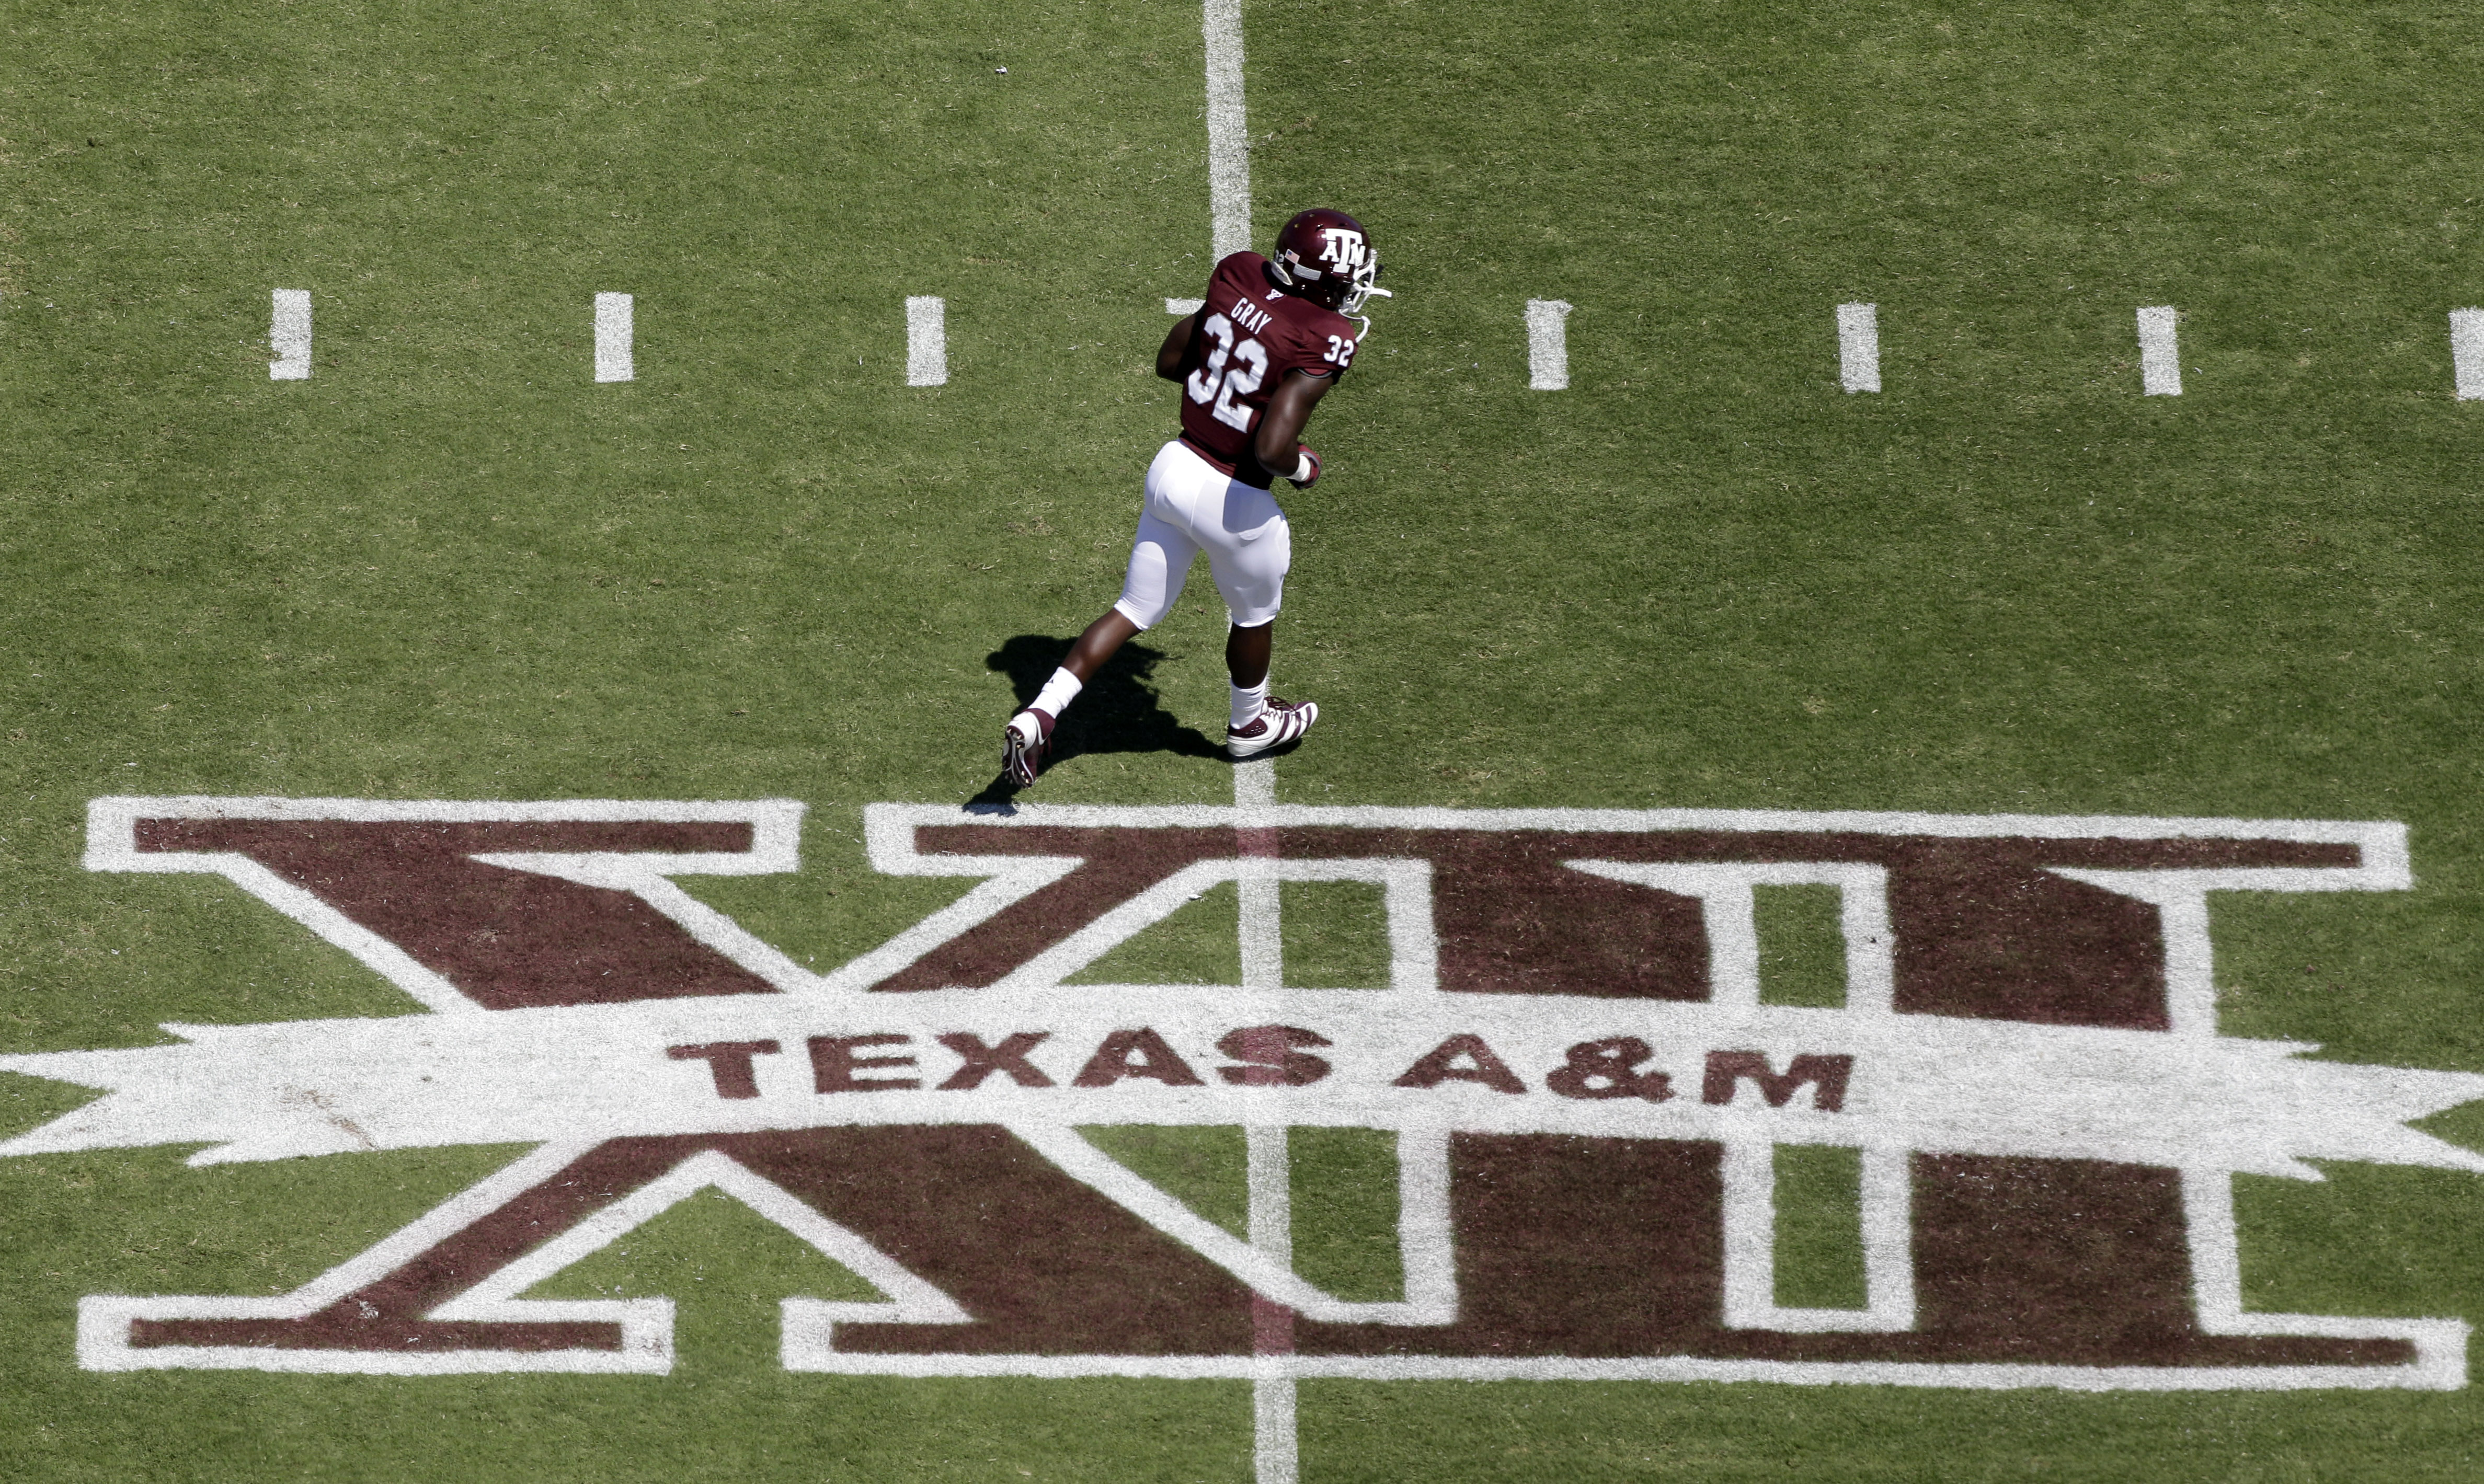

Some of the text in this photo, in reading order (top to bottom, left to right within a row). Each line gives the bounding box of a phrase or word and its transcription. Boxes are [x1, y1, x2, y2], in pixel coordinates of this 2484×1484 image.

[1231, 297, 1272, 335] GRAY
[1188, 313, 1268, 433] 32
[1323, 335, 1354, 367] 32
[667, 1025, 1855, 1112] TEXAS A&M
